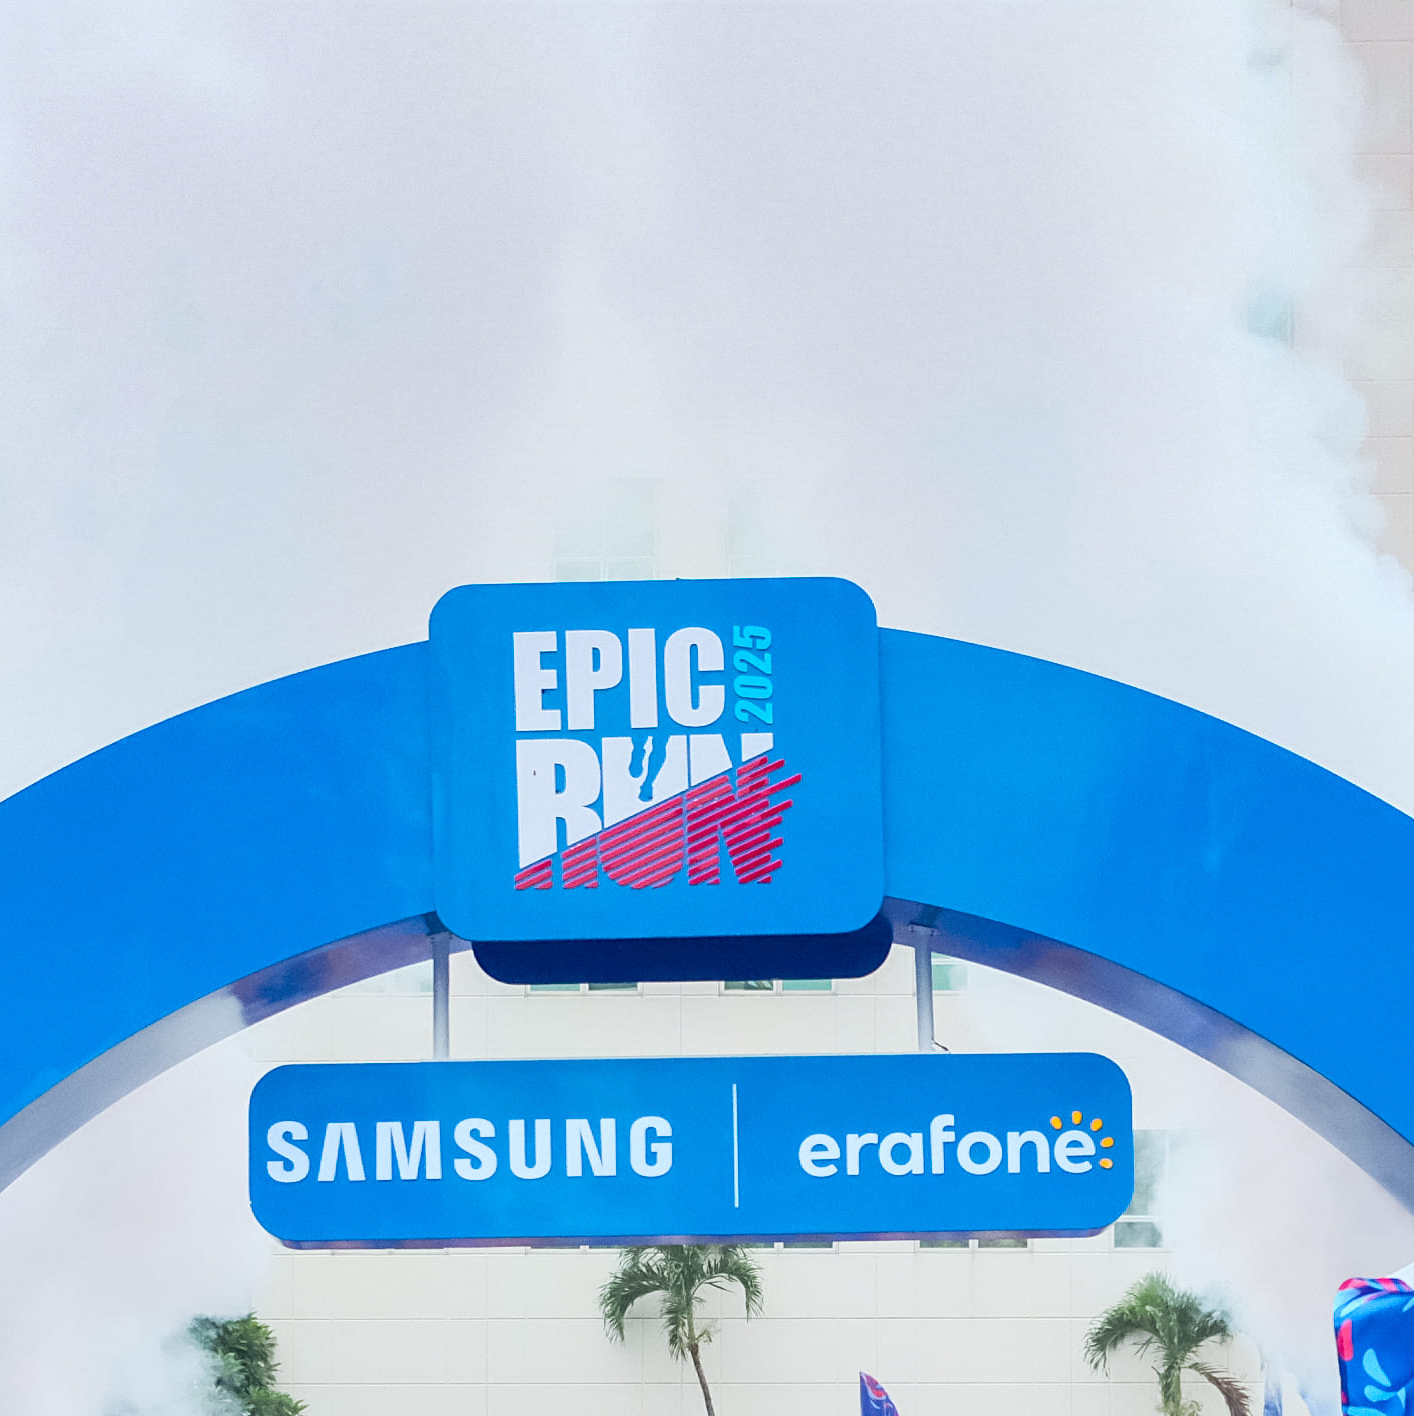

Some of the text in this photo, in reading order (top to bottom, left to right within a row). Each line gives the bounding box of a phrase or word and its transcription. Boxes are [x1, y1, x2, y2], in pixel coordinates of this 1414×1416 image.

[513, 627, 725, 731] EPIC
[733, 625, 774, 724] 2025
[515, 733, 802, 890] RUN
[266, 1112, 1113, 1184] SAMSUNG erafone
